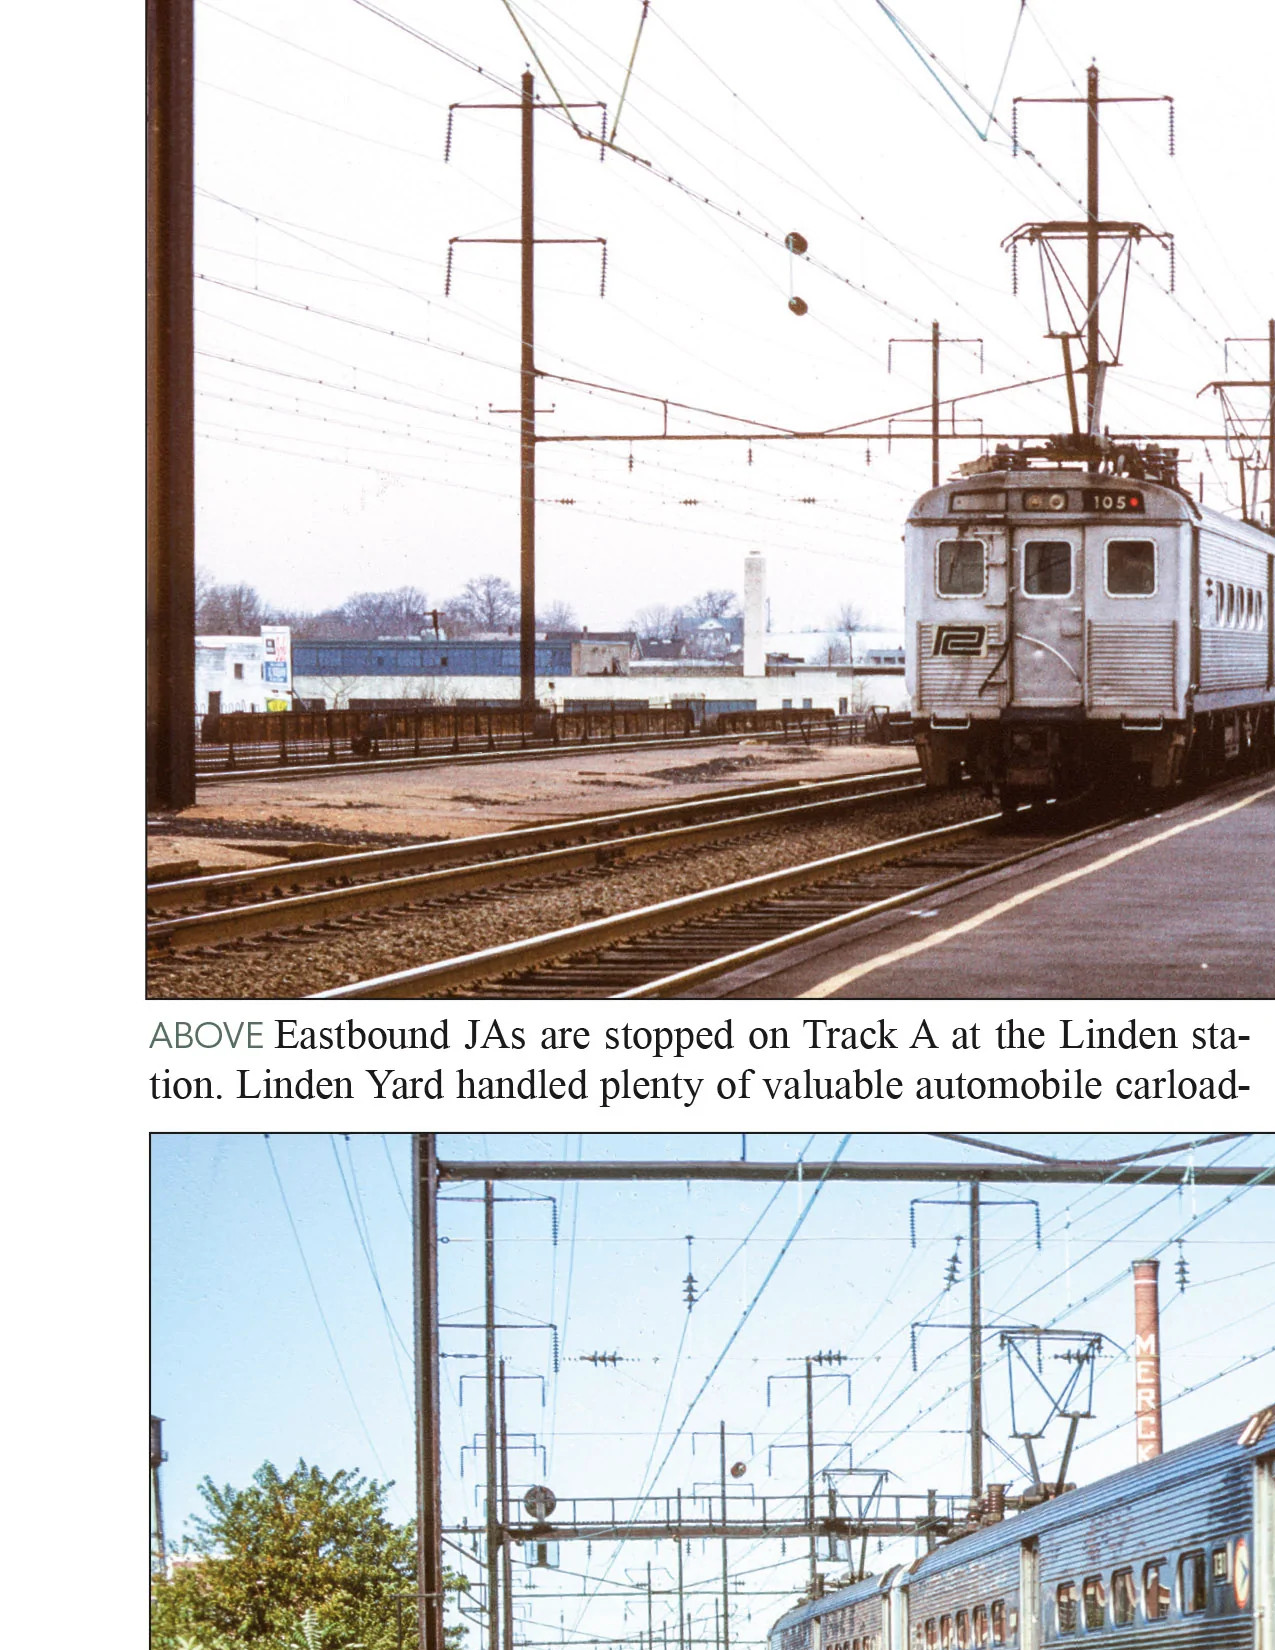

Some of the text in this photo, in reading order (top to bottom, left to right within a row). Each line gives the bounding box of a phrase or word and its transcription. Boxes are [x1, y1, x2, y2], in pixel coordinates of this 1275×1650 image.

[1094, 495, 1126, 510] 105
[149, 1019, 1250, 1057] ABOVE Eastbound JAs are stopped on Track A at the Linden sta-
[149, 1069, 1250, 1107] tion. Linden Yard handled plenty of valuable automobile carload-
[1136, 1333, 1156, 1464] MERCK
